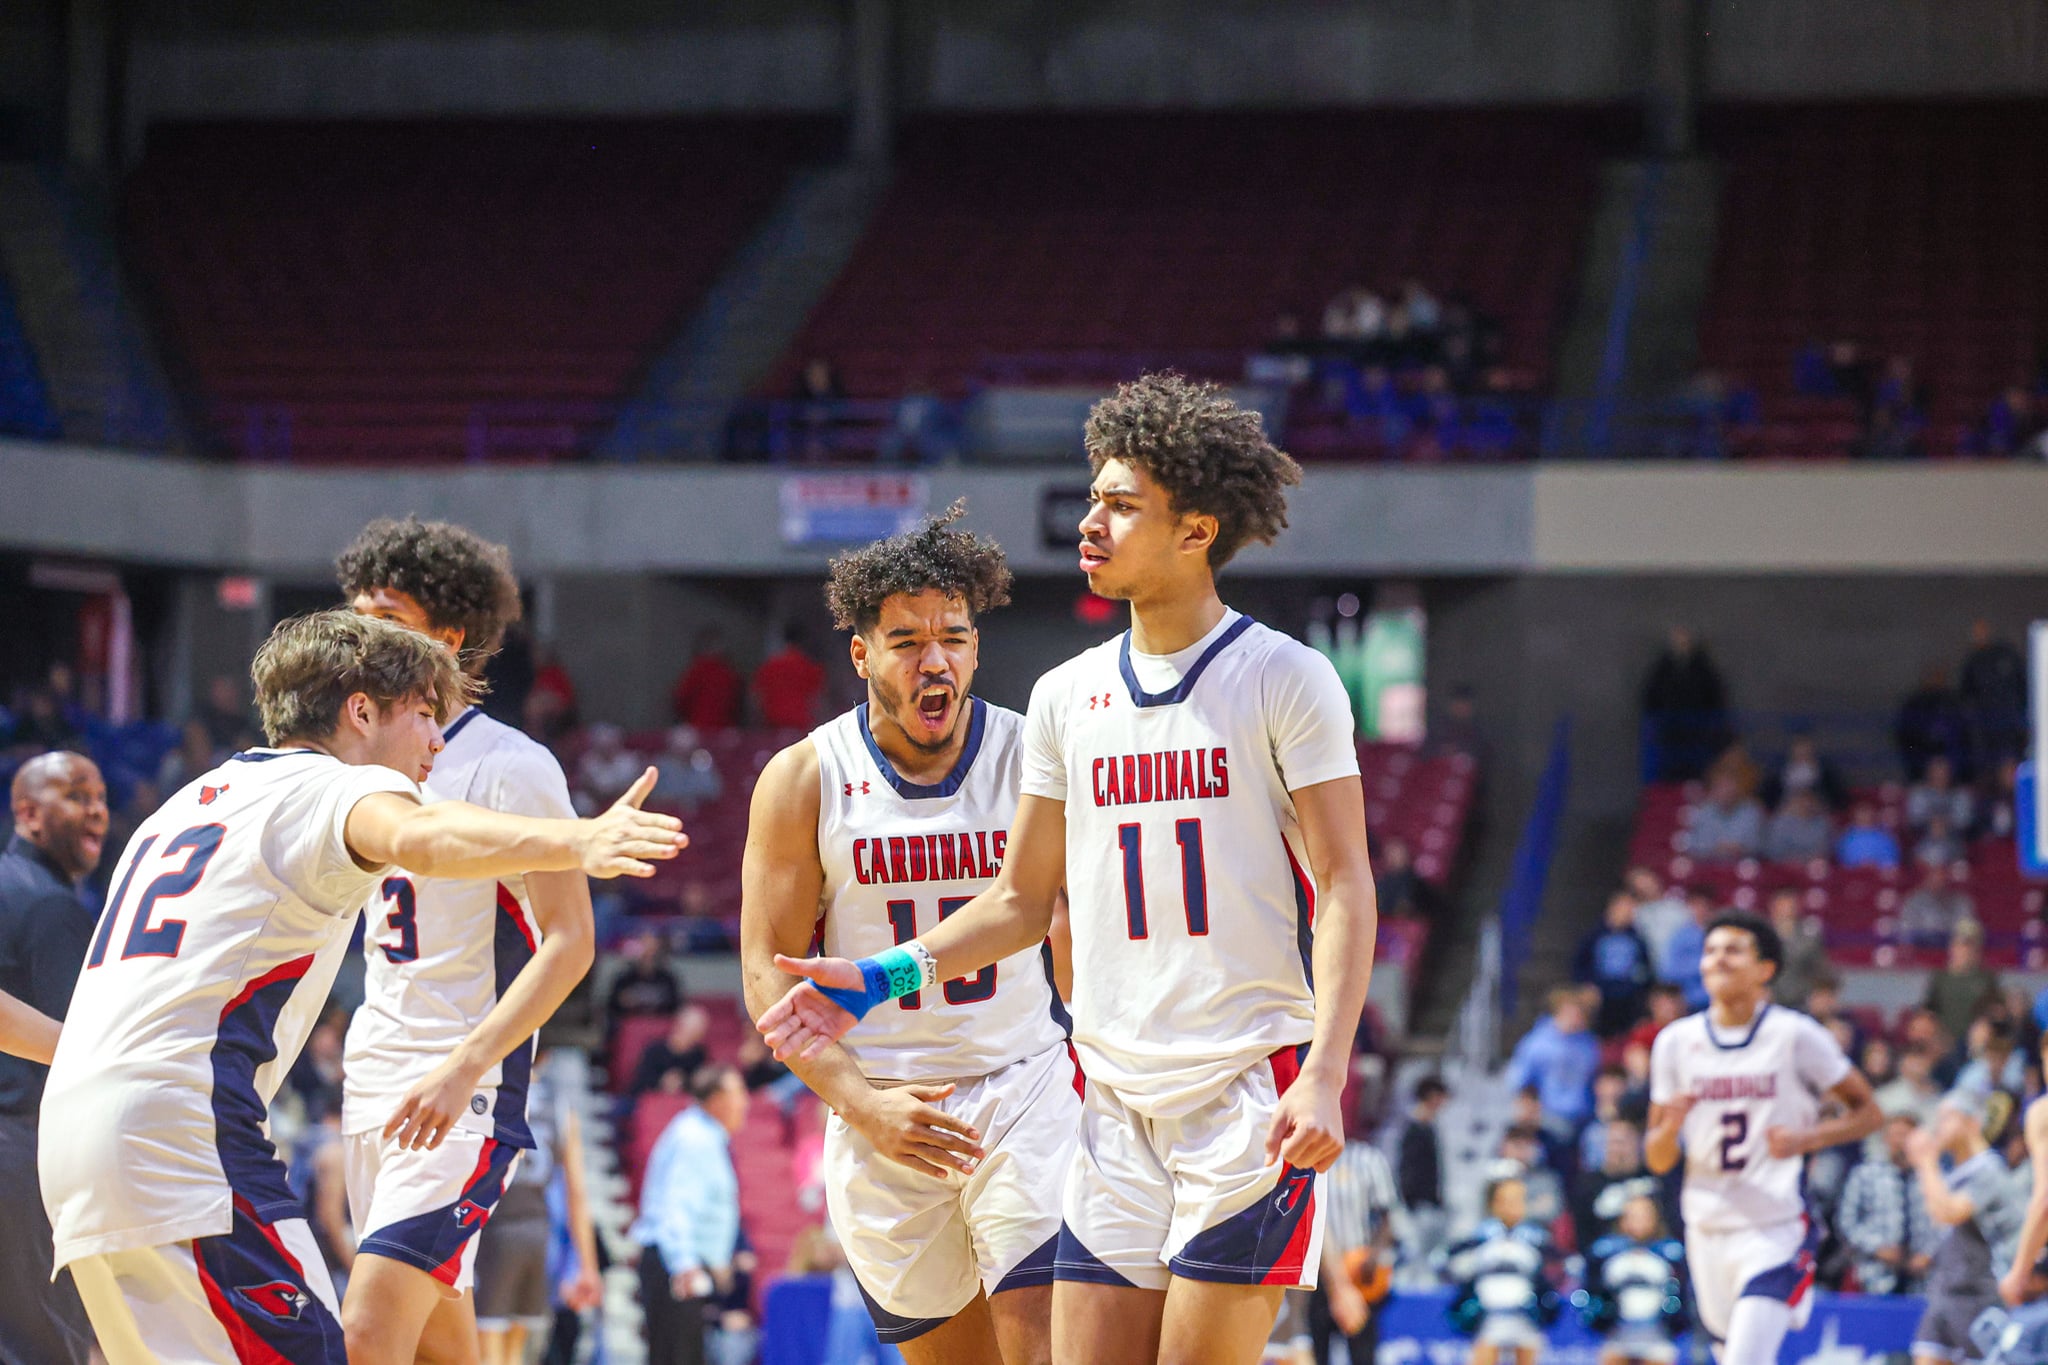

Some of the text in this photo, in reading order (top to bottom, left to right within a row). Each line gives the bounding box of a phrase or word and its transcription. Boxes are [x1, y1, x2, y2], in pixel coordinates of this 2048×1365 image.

[1092, 747, 1229, 807] CARDINALS
[853, 830, 1008, 885] CARDINALS
[1118, 818, 1209, 940] 11
[87, 822, 228, 970] 12
[378, 876, 419, 965] 3
[888, 966, 905, 997] GOT
[903, 963, 916, 991] ME
[1719, 1110, 1748, 1171] 2
